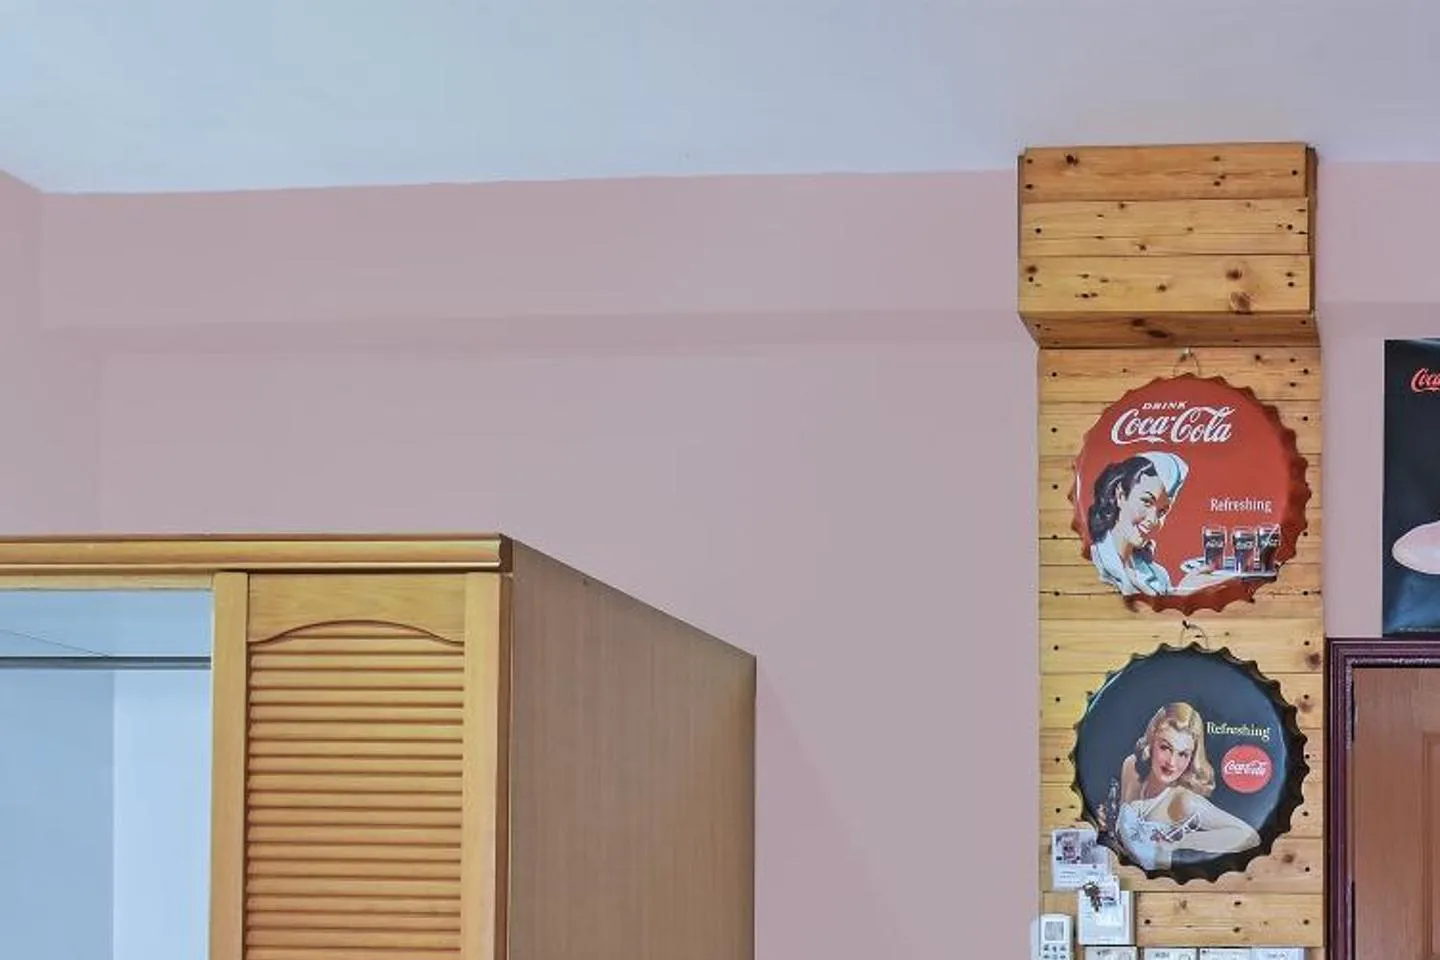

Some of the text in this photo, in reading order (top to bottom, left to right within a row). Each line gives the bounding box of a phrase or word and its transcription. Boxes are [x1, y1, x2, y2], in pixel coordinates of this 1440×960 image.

[1141, 401, 1188, 411] DRINK
[1110, 405, 1236, 445] Coca-Cola
[1210, 498, 1273, 514] Refreshing
[1206, 721, 1271, 741] Refreshing
